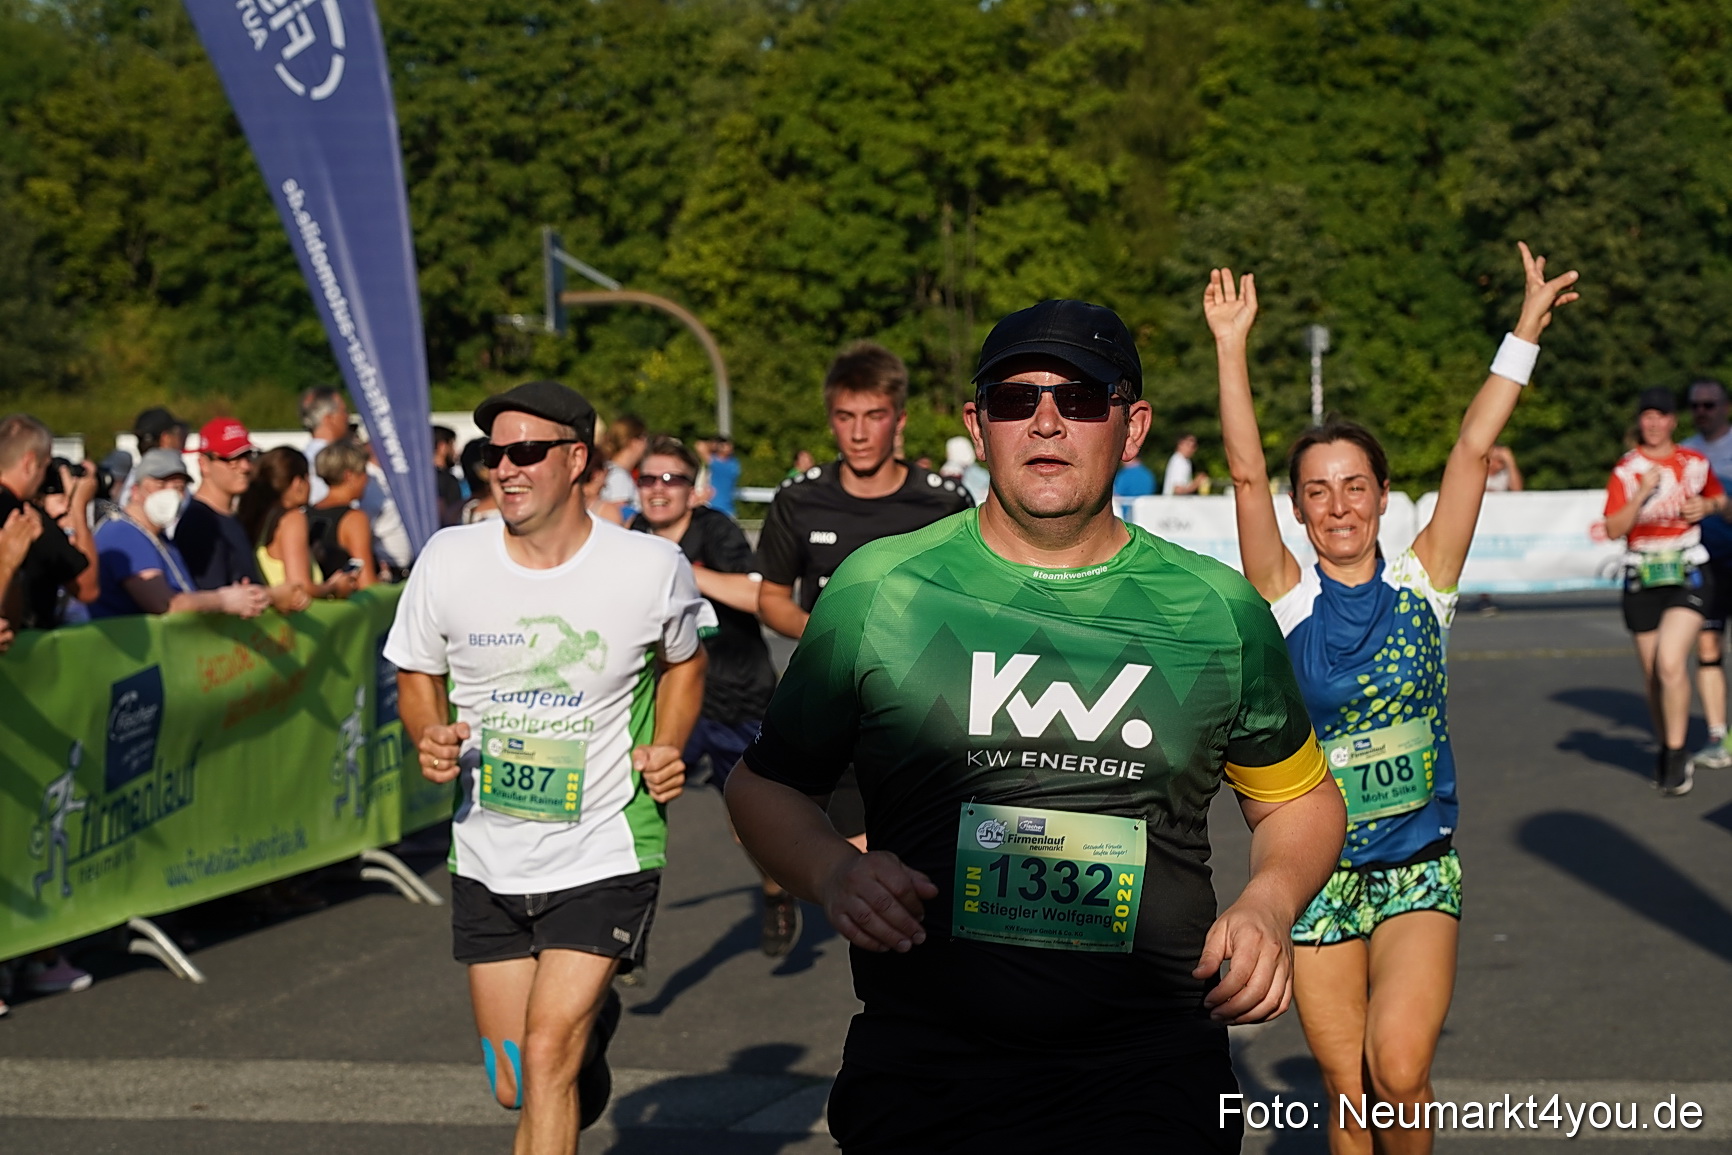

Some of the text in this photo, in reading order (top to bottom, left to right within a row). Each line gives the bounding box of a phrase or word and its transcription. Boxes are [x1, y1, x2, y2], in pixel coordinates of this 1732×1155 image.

[1033, 565, 1108, 580] #teamkwenergie
[469, 634, 526, 647] BERATA
[501, 761, 556, 793] 387
[967, 750, 1146, 780] KW ENERGIE
[1353, 754, 1414, 791] 708
[1007, 834, 1066, 845] Firmenlauf
[964, 866, 982, 912] RUN
[989, 854, 1113, 907] 1332
[979, 901, 1112, 928] Stiegler Wolfgang
[1112, 873, 1134, 933] 2022
[1016, 926, 1038, 934] Energie
